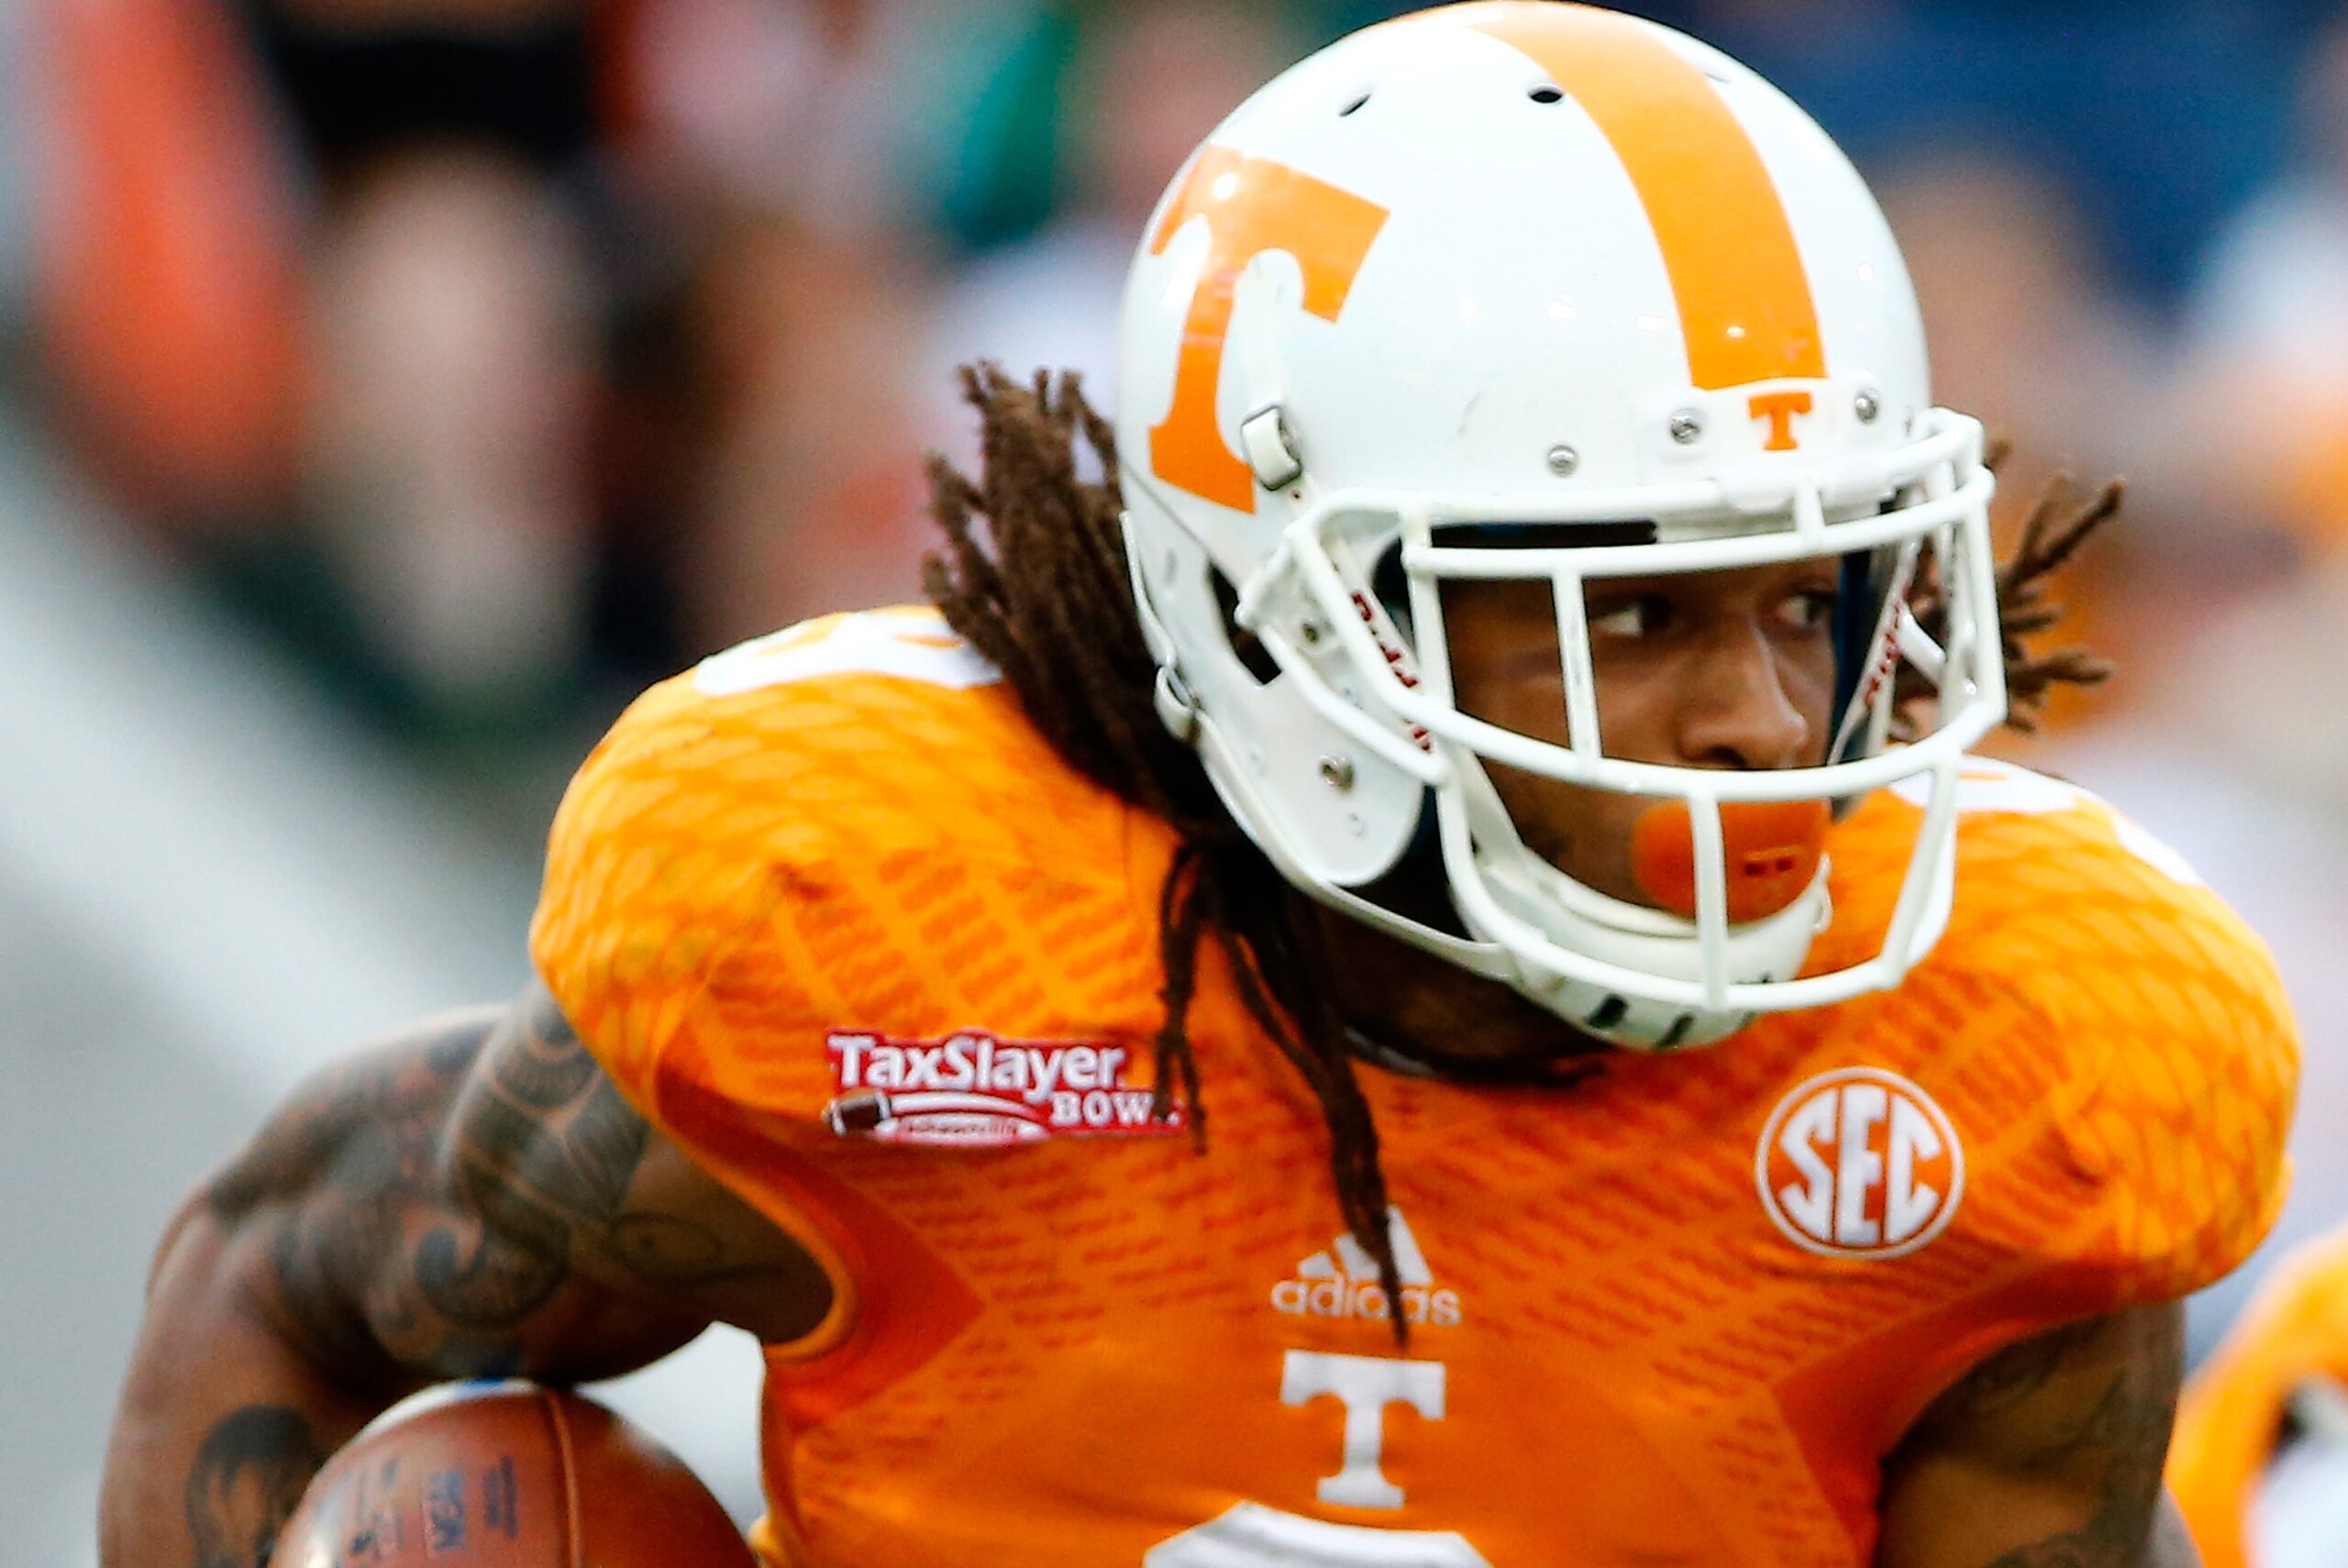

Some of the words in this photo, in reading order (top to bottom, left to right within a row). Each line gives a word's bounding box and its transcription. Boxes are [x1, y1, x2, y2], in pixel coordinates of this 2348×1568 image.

[1148, 144, 1390, 515] T
[1749, 392, 1811, 450] T
[828, 1033, 1124, 1101] TaxSlayer
[1779, 1084, 1941, 1247] SEC
[1280, 1349, 1446, 1509] T
